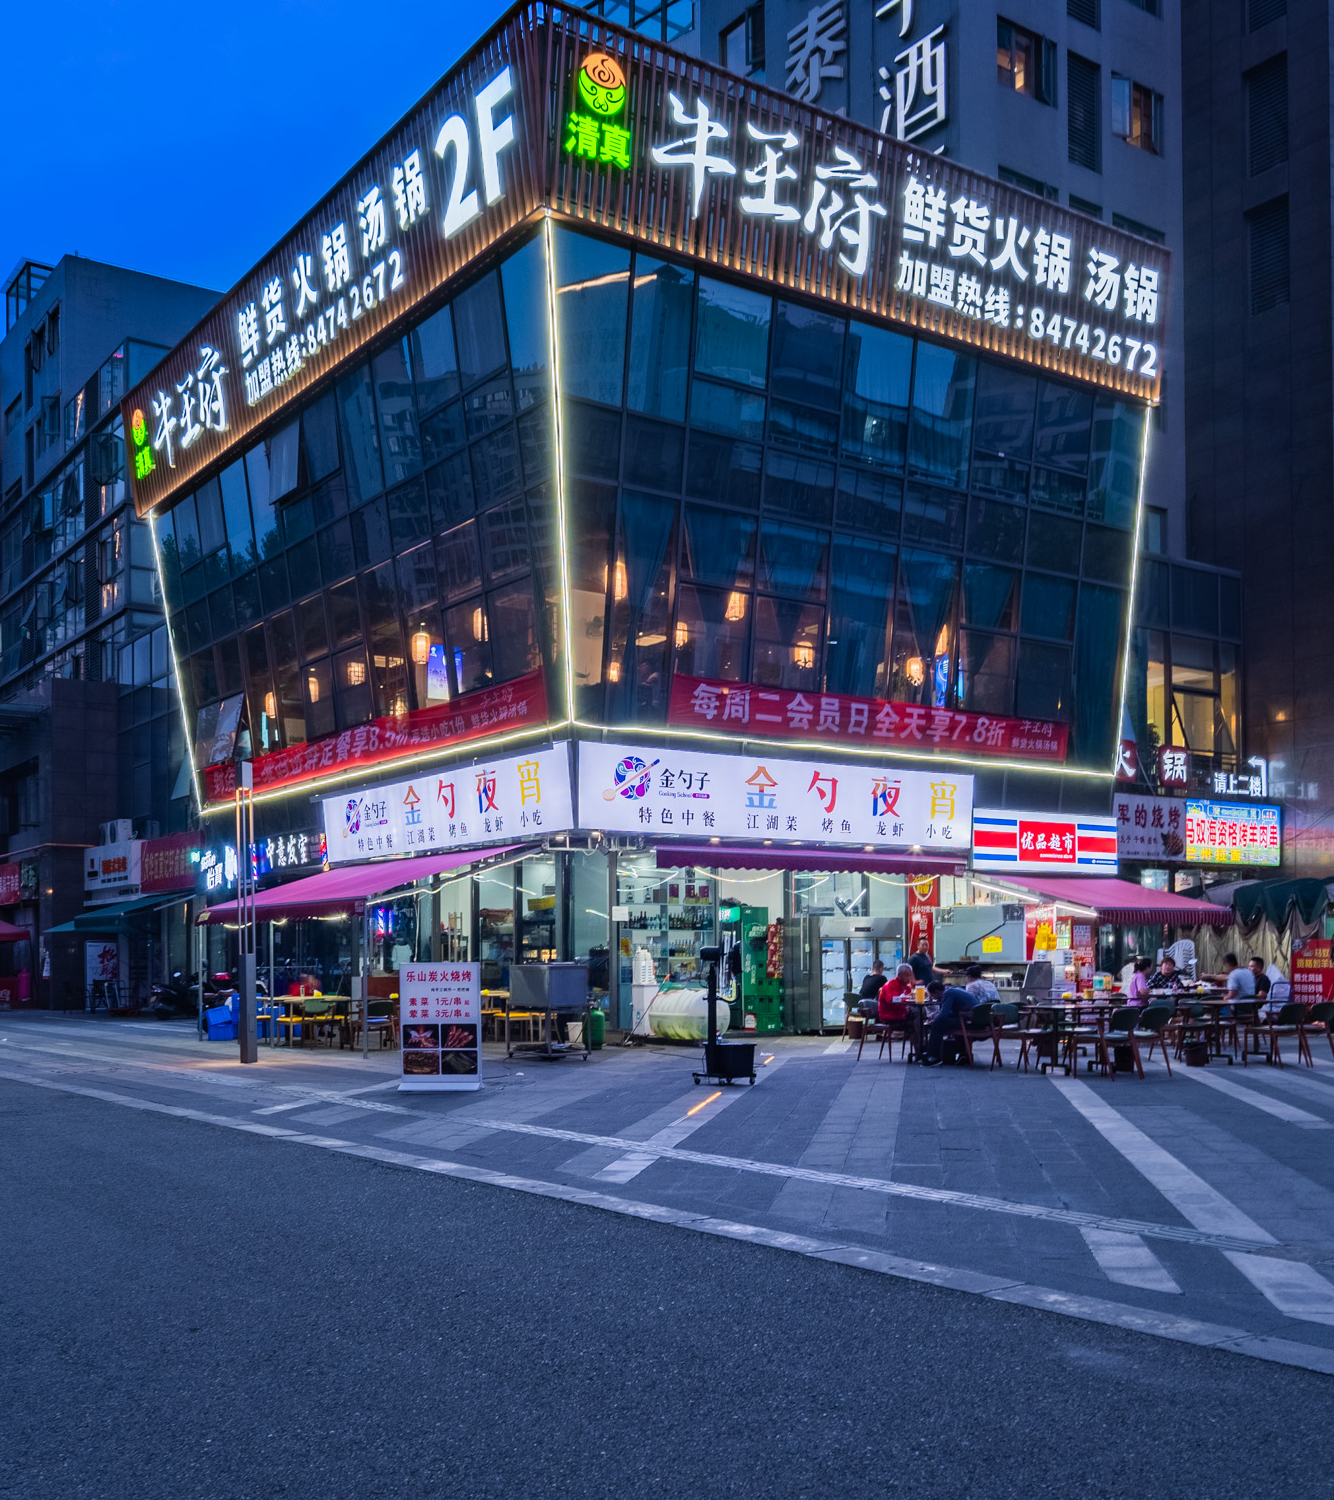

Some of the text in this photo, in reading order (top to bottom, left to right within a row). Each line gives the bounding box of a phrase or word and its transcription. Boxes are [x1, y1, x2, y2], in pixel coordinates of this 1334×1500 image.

[435, 66, 515, 240] 2F
[566, 112, 630, 169] 清真
[652, 93, 887, 275] 牛王府
[153, 347, 229, 468] 牛王府
[135, 451, 155, 479] 清真
[691, 682, 1007, 747] 每周二会员日全天享7.8折
[402, 760, 541, 826] 金勺夜宵
[659, 768, 710, 791] 金勺子
[745, 765, 958, 820] 金勺夜宵
[1214, 772, 1262, 797] 请上二楼
[364, 801, 388, 821] 金勺子
[638, 806, 953, 841] 特色中餐 江湖菜 烤鱼 龙虾 小吃
[407, 827, 436, 845] 江湖菜
[520, 810, 543, 828] 小吃
[1021, 831, 1074, 854] 优品超市
[1186, 847, 1241, 862] 兰州拉面
[406, 970, 471, 982] 乐山炭火烧烤
[435, 997, 462, 1006] 1元/串
[435, 1009, 462, 1018] 3元/串
